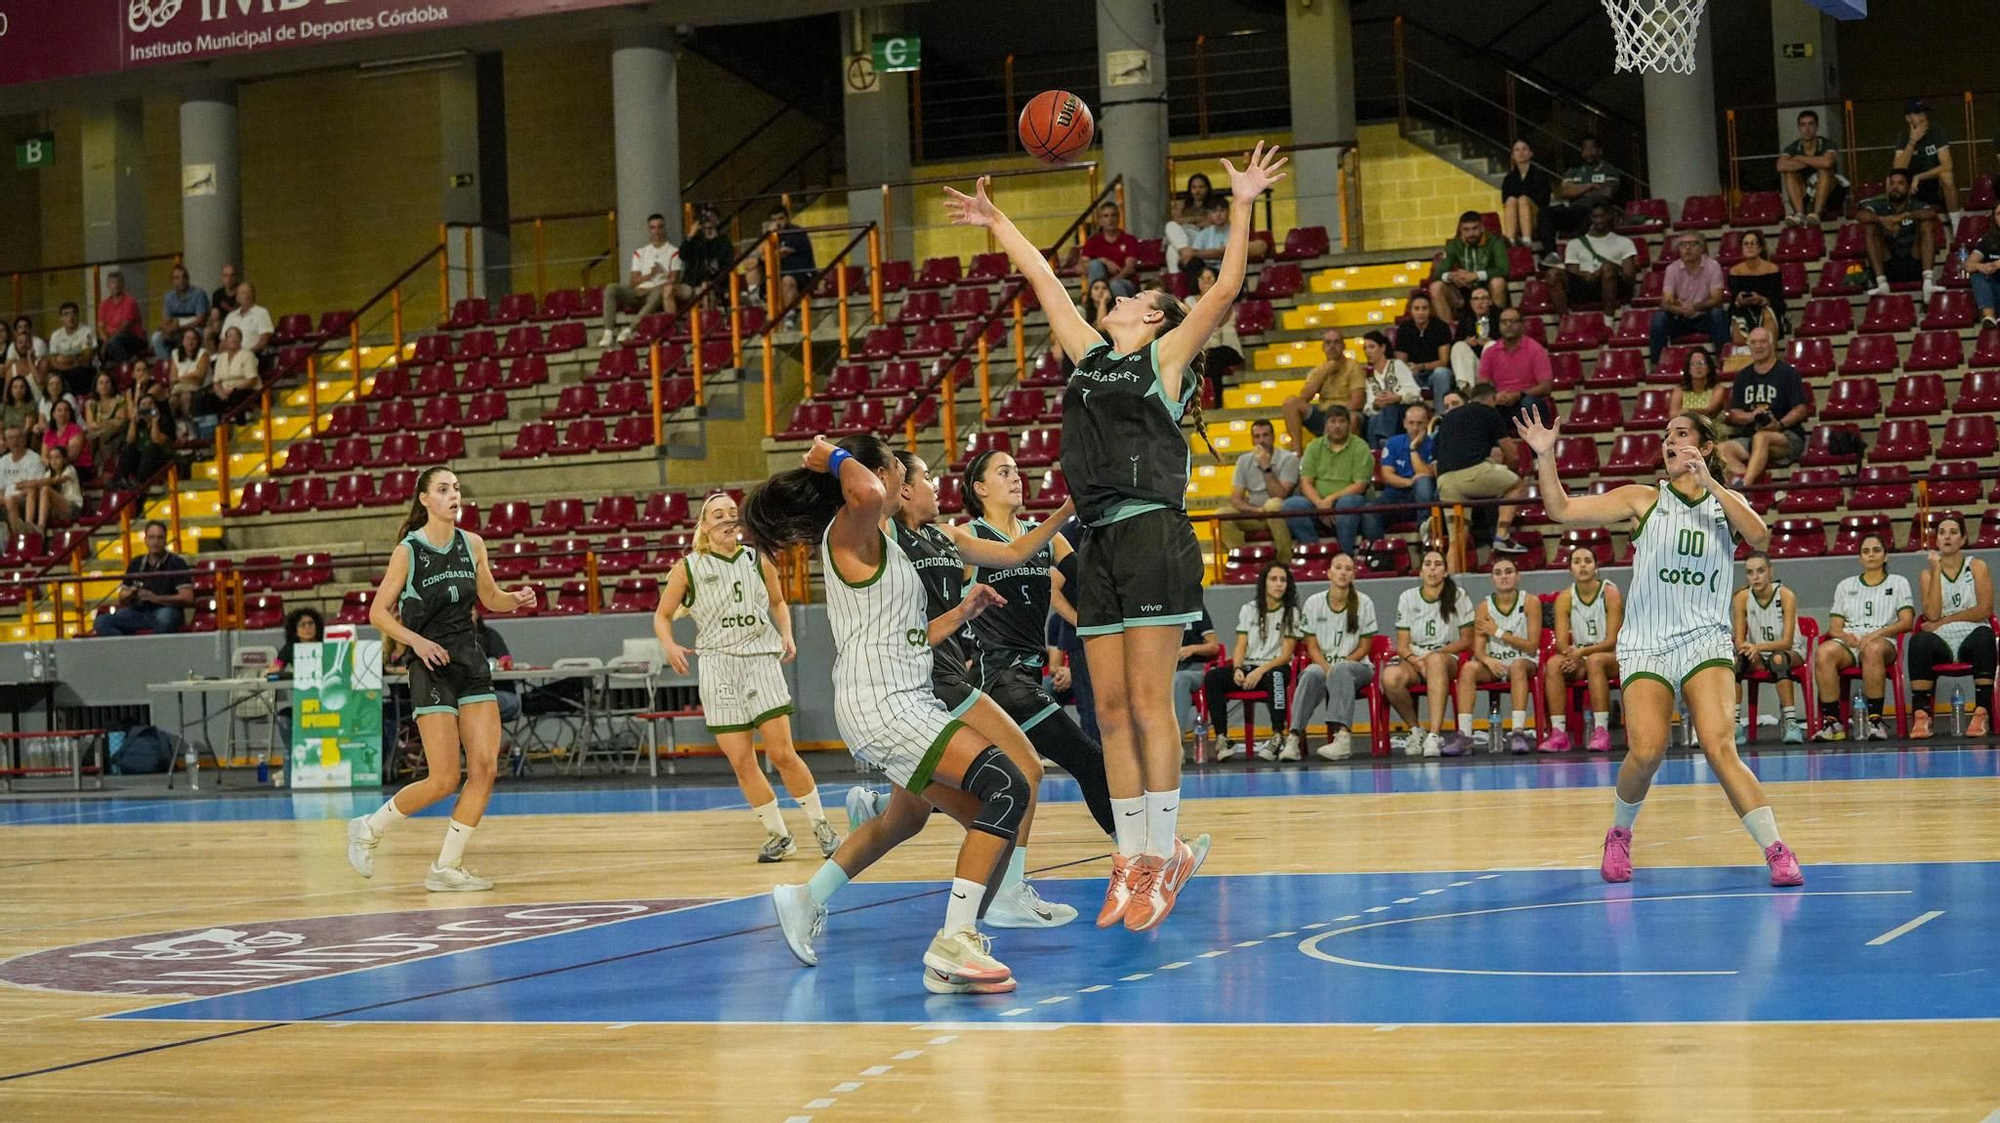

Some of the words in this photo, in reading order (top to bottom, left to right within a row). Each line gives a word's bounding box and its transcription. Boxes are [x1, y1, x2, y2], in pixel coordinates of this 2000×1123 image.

[130, 40, 192, 61] Instituto
[196, 27, 271, 51] Municipal
[275, 26, 296, 41] de
[300, 17, 374, 40] Deportes
[377, 6, 448, 28] Córdoba
[885, 38, 906, 65] C
[27, 140, 42, 163] B
[1744, 384, 1777, 404] GAP
[1678, 528, 1704, 558] 00
[1659, 567, 1705, 586] coto
[448, 585, 459, 603] 10
[1140, 603, 1163, 612] vive
[1865, 601, 1873, 617] 9
[722, 614, 756, 628] coto
[1425, 620, 1436, 636] 16
